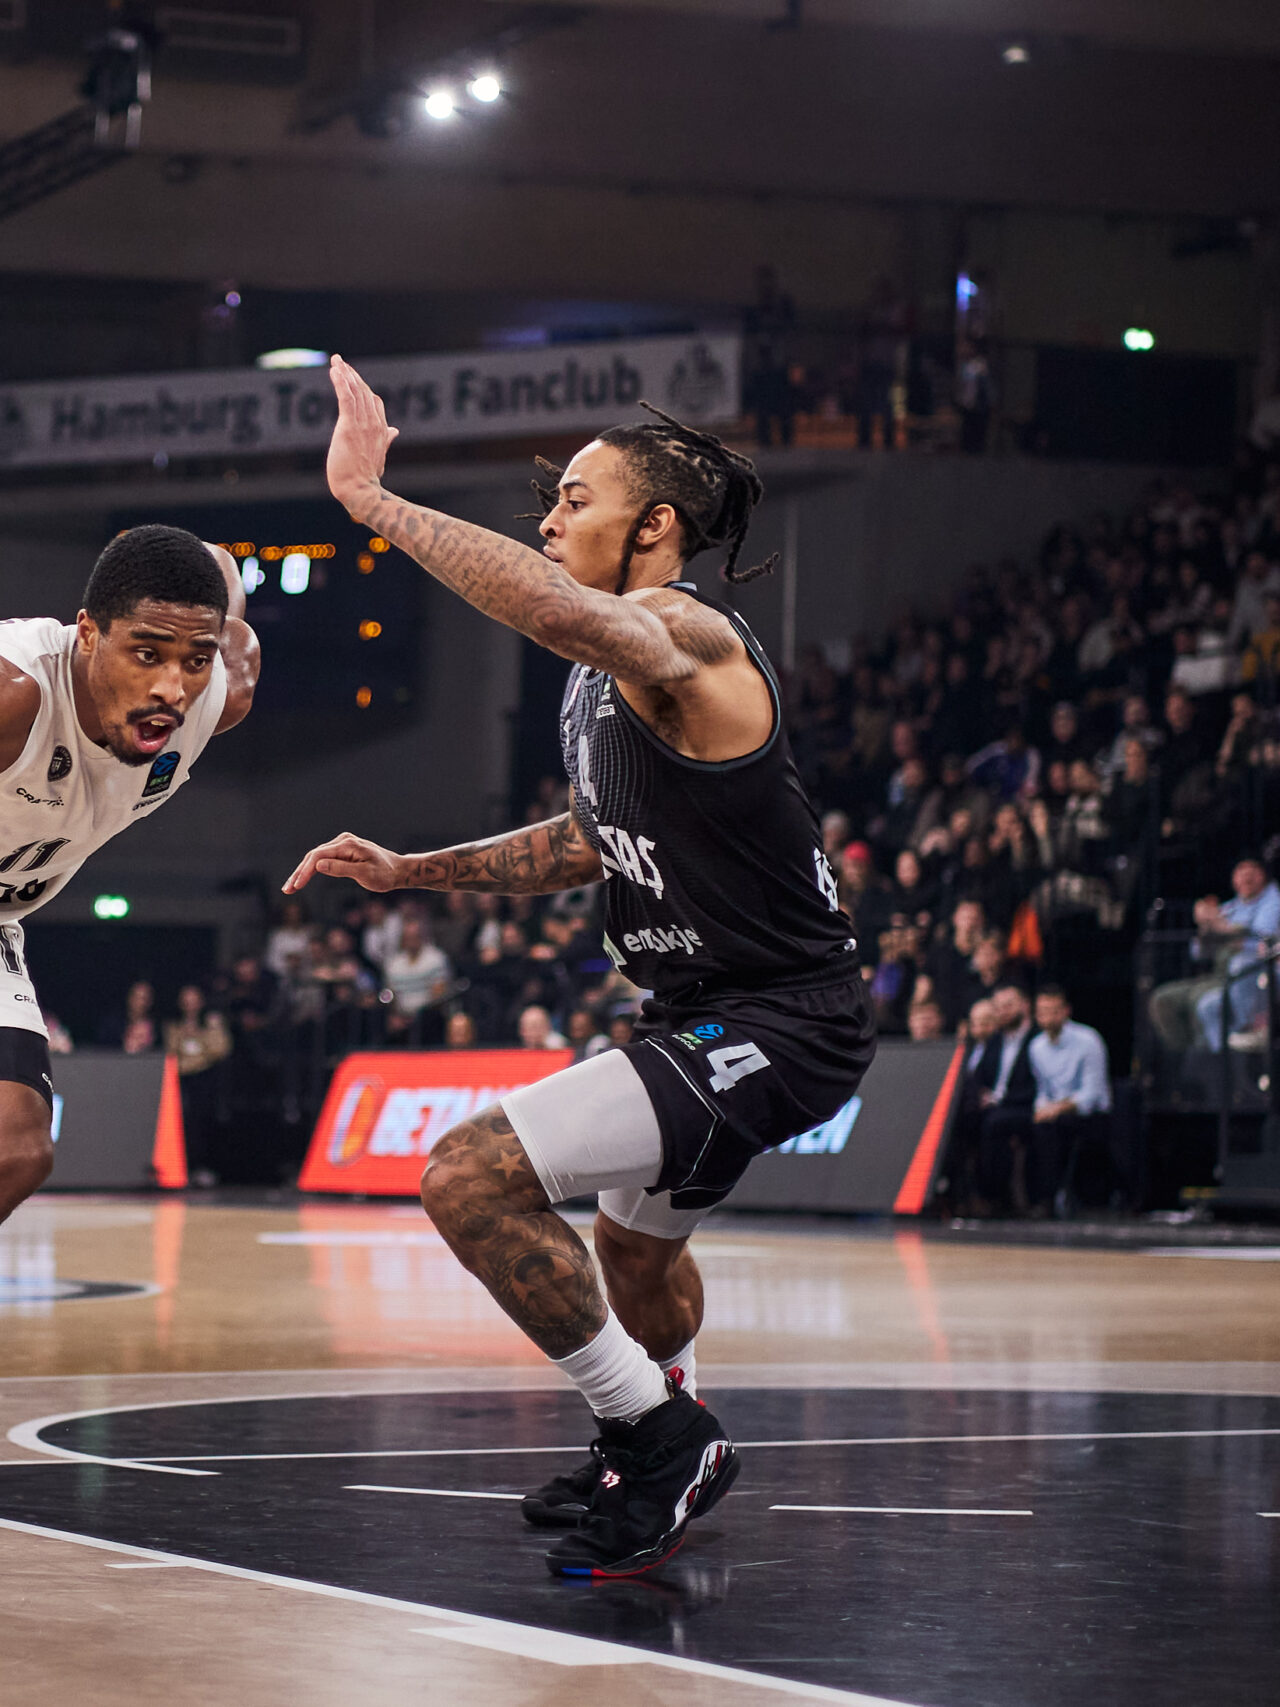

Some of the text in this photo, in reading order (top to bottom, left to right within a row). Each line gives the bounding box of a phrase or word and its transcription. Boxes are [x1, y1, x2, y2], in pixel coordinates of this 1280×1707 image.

[271, 378, 439, 428] Toers
[453, 355, 642, 416] Fanclub
[706, 1042, 771, 1093] 4
